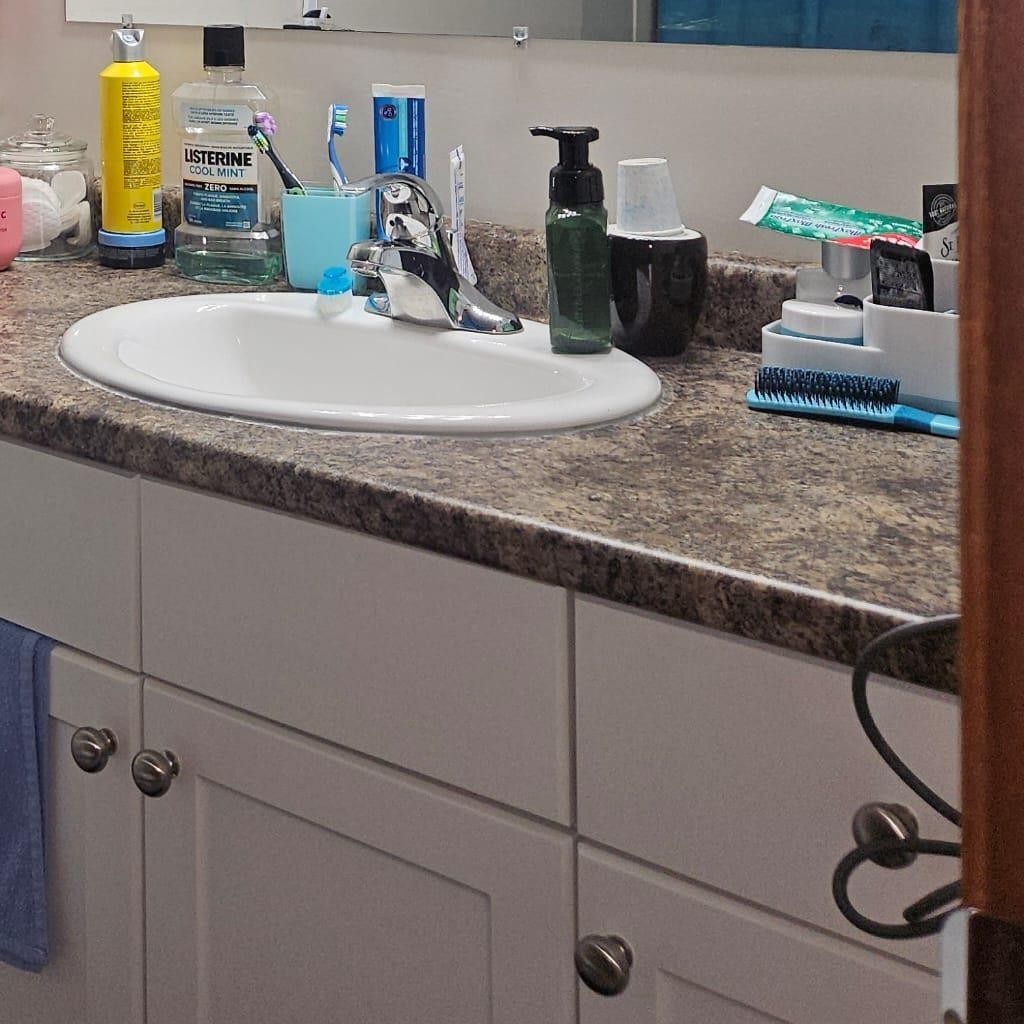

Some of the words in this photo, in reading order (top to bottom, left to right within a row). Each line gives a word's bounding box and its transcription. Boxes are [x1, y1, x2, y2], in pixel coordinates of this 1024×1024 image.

[184, 148, 252, 167] LISTERINE
[189, 165, 215, 177] COOL
[217, 167, 246, 178] MINT
[204, 183, 228, 192] ZERO
